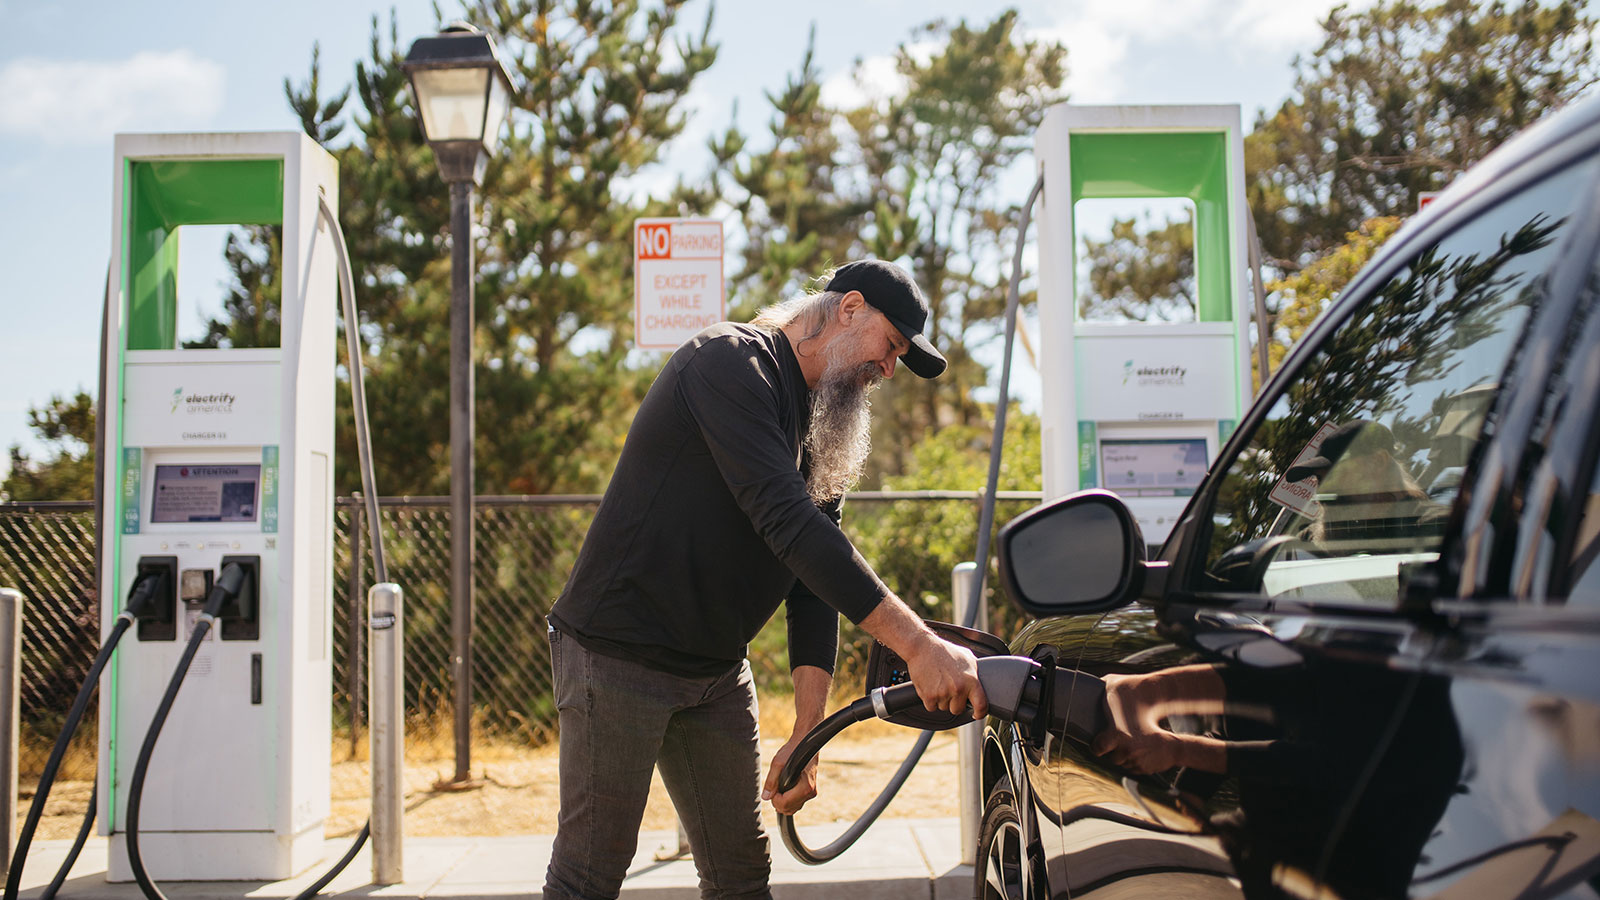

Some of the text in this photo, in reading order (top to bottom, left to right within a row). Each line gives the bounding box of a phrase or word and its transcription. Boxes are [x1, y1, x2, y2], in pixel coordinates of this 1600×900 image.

[639, 226, 720, 257] NO PARKING
[653, 273, 708, 290] EXCEPT
[660, 294, 702, 310] WHILE
[644, 314, 718, 330] CHARGING
[1137, 364, 1187, 380] electrify
[186, 392, 236, 406] electrify
[186, 404, 233, 414] america
[182, 431, 216, 440] CHARGER
[192, 466, 239, 476] ATTENTION
[125, 468, 135, 497] Ultra
[264, 467, 273, 495] Ultra
